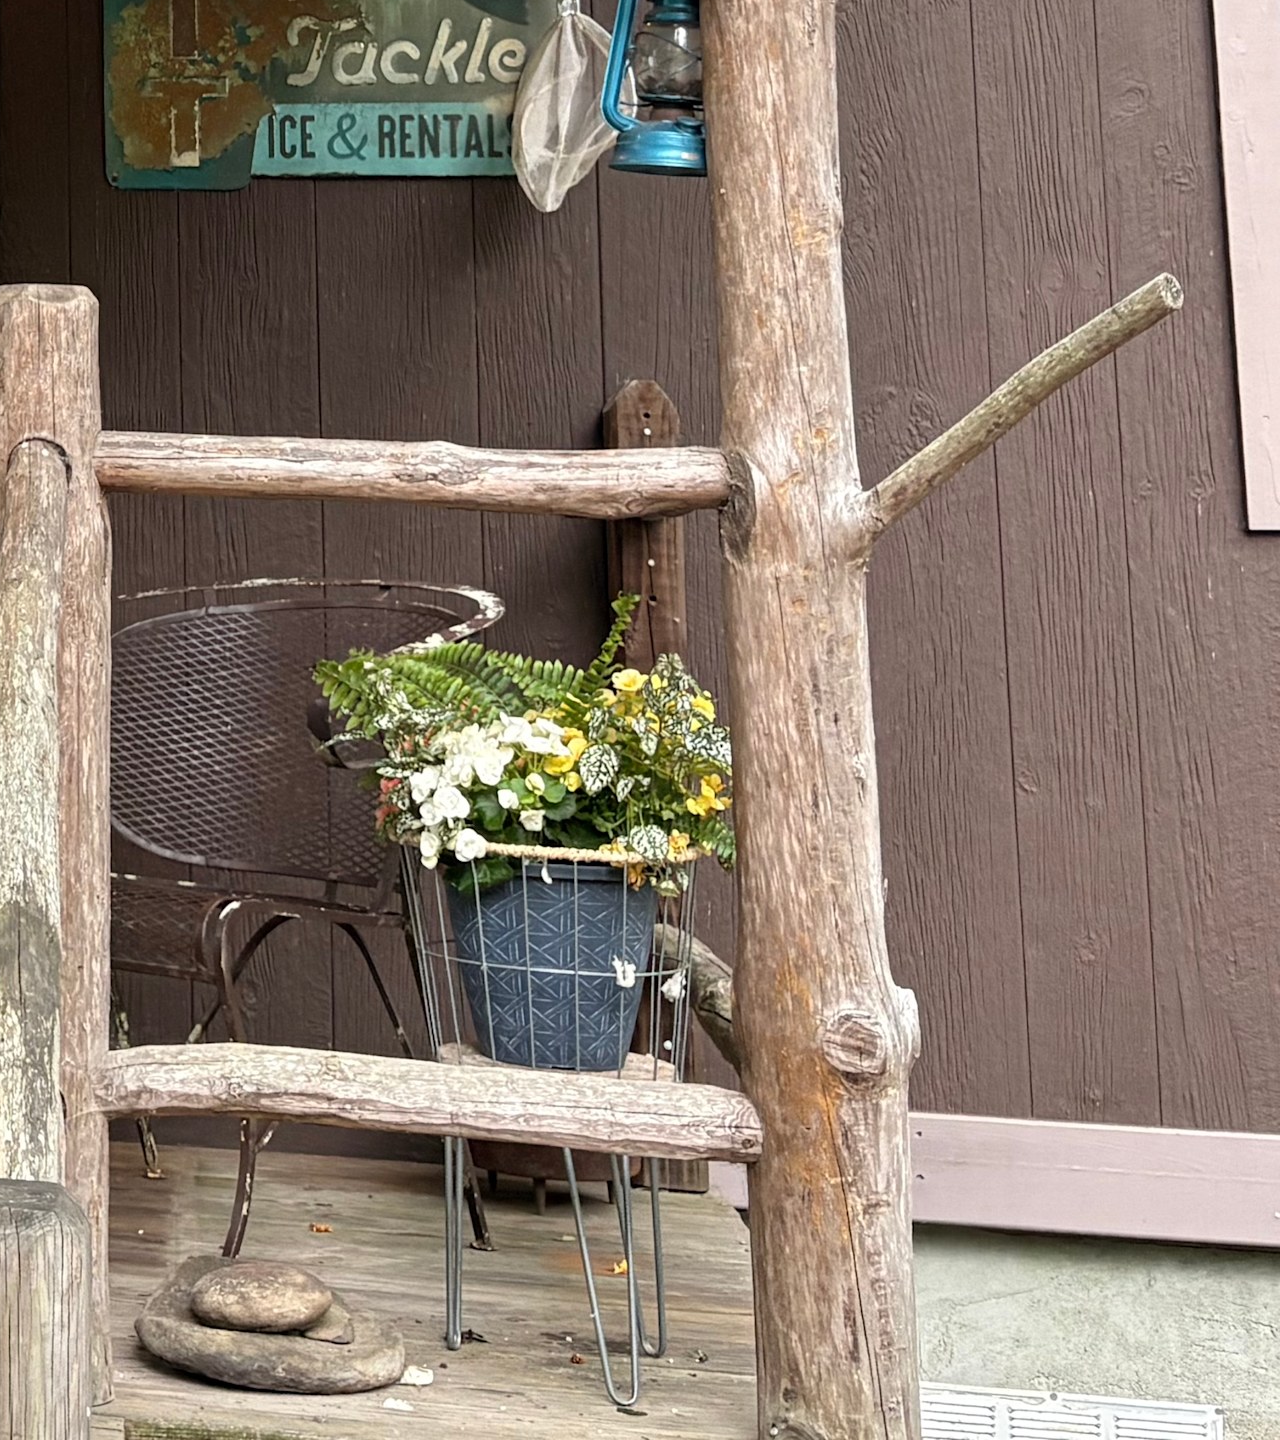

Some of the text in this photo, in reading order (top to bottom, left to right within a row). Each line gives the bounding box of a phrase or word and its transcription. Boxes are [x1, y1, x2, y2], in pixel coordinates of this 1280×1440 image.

[286, 16, 527, 86] Tackle
[268, 114, 316, 159] ICE
[327, 112, 369, 161] &
